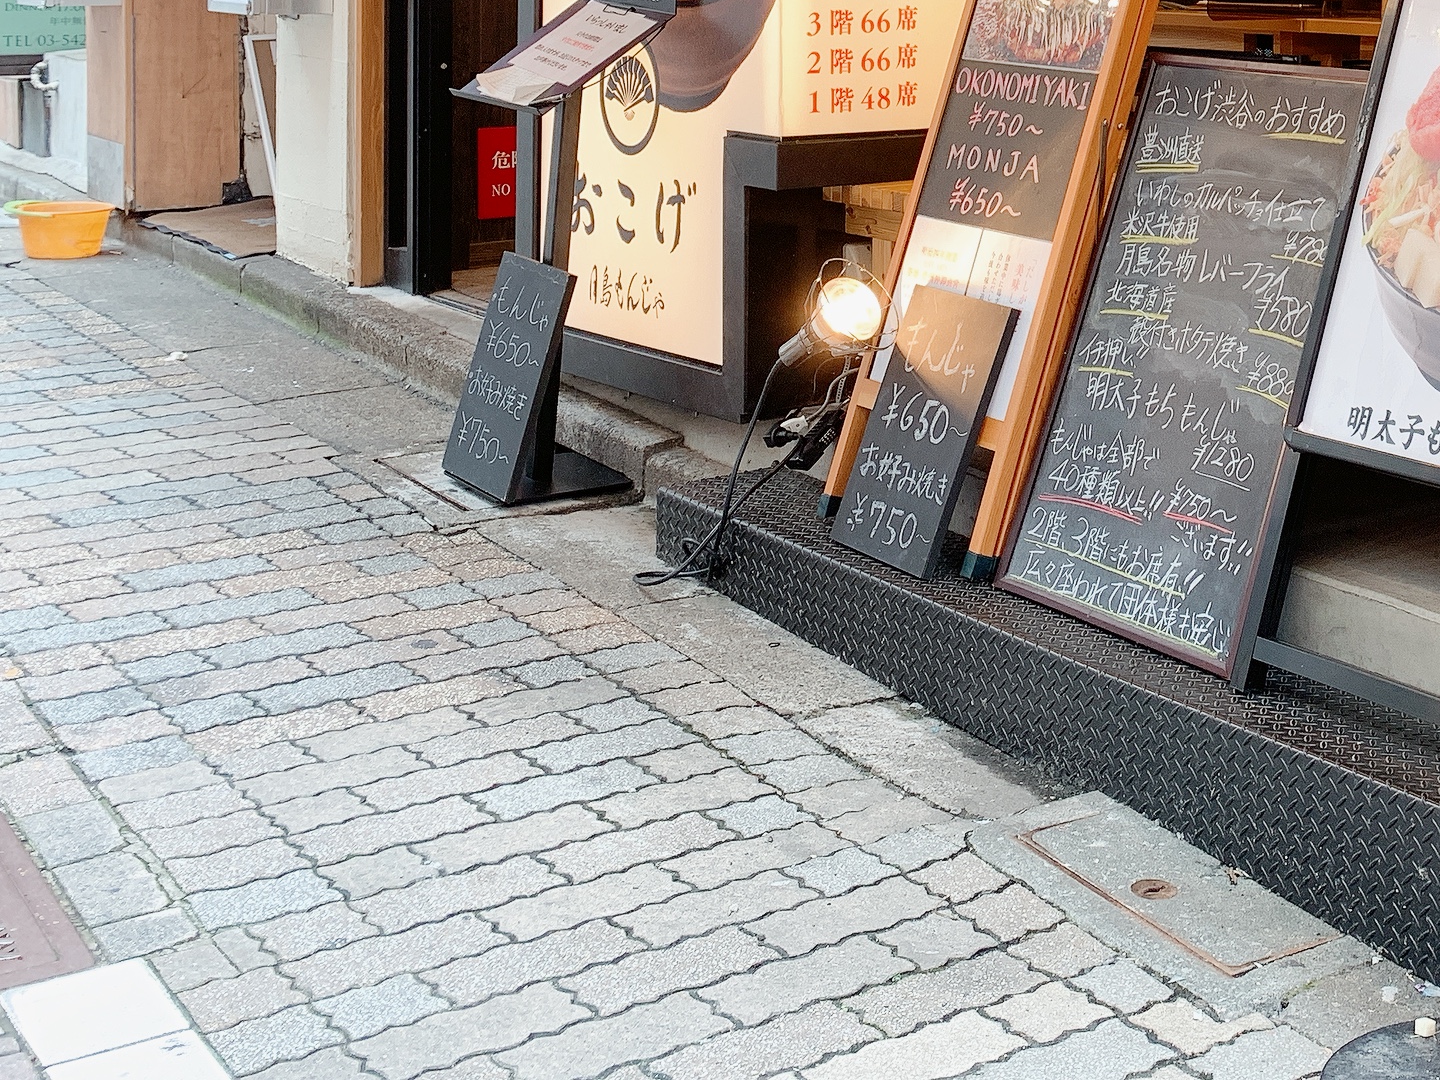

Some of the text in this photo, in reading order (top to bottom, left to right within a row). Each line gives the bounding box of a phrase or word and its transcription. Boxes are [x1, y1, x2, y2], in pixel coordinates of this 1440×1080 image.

[3, 35, 33, 48] TEL
[955, 66, 1091, 111] OKONOMIYAKI
[1155, 79, 1347, 137] おこげ渋谷のおすすめ
[946, 143, 1040, 184] MONJA
[1137, 123, 1205, 165] 豊洲直送
[491, 183, 511, 197] NO
[571, 160, 697, 254] おこげ
[1121, 210, 1200, 242] 米沢牛使用
[589, 264, 665, 319] 月島もんじゃ
[1105, 279, 1178, 314] 北海道産
[1116, 243, 1290, 299] 月島名物レバーフライ
[495, 275, 549, 332] もんじゃ
[903, 317, 976, 394] もんじゃ
[467, 365, 528, 421] お好み焼き
[859, 442, 948, 506] お好み焼き
[1051, 418, 1160, 476] もんじゃは全部で
